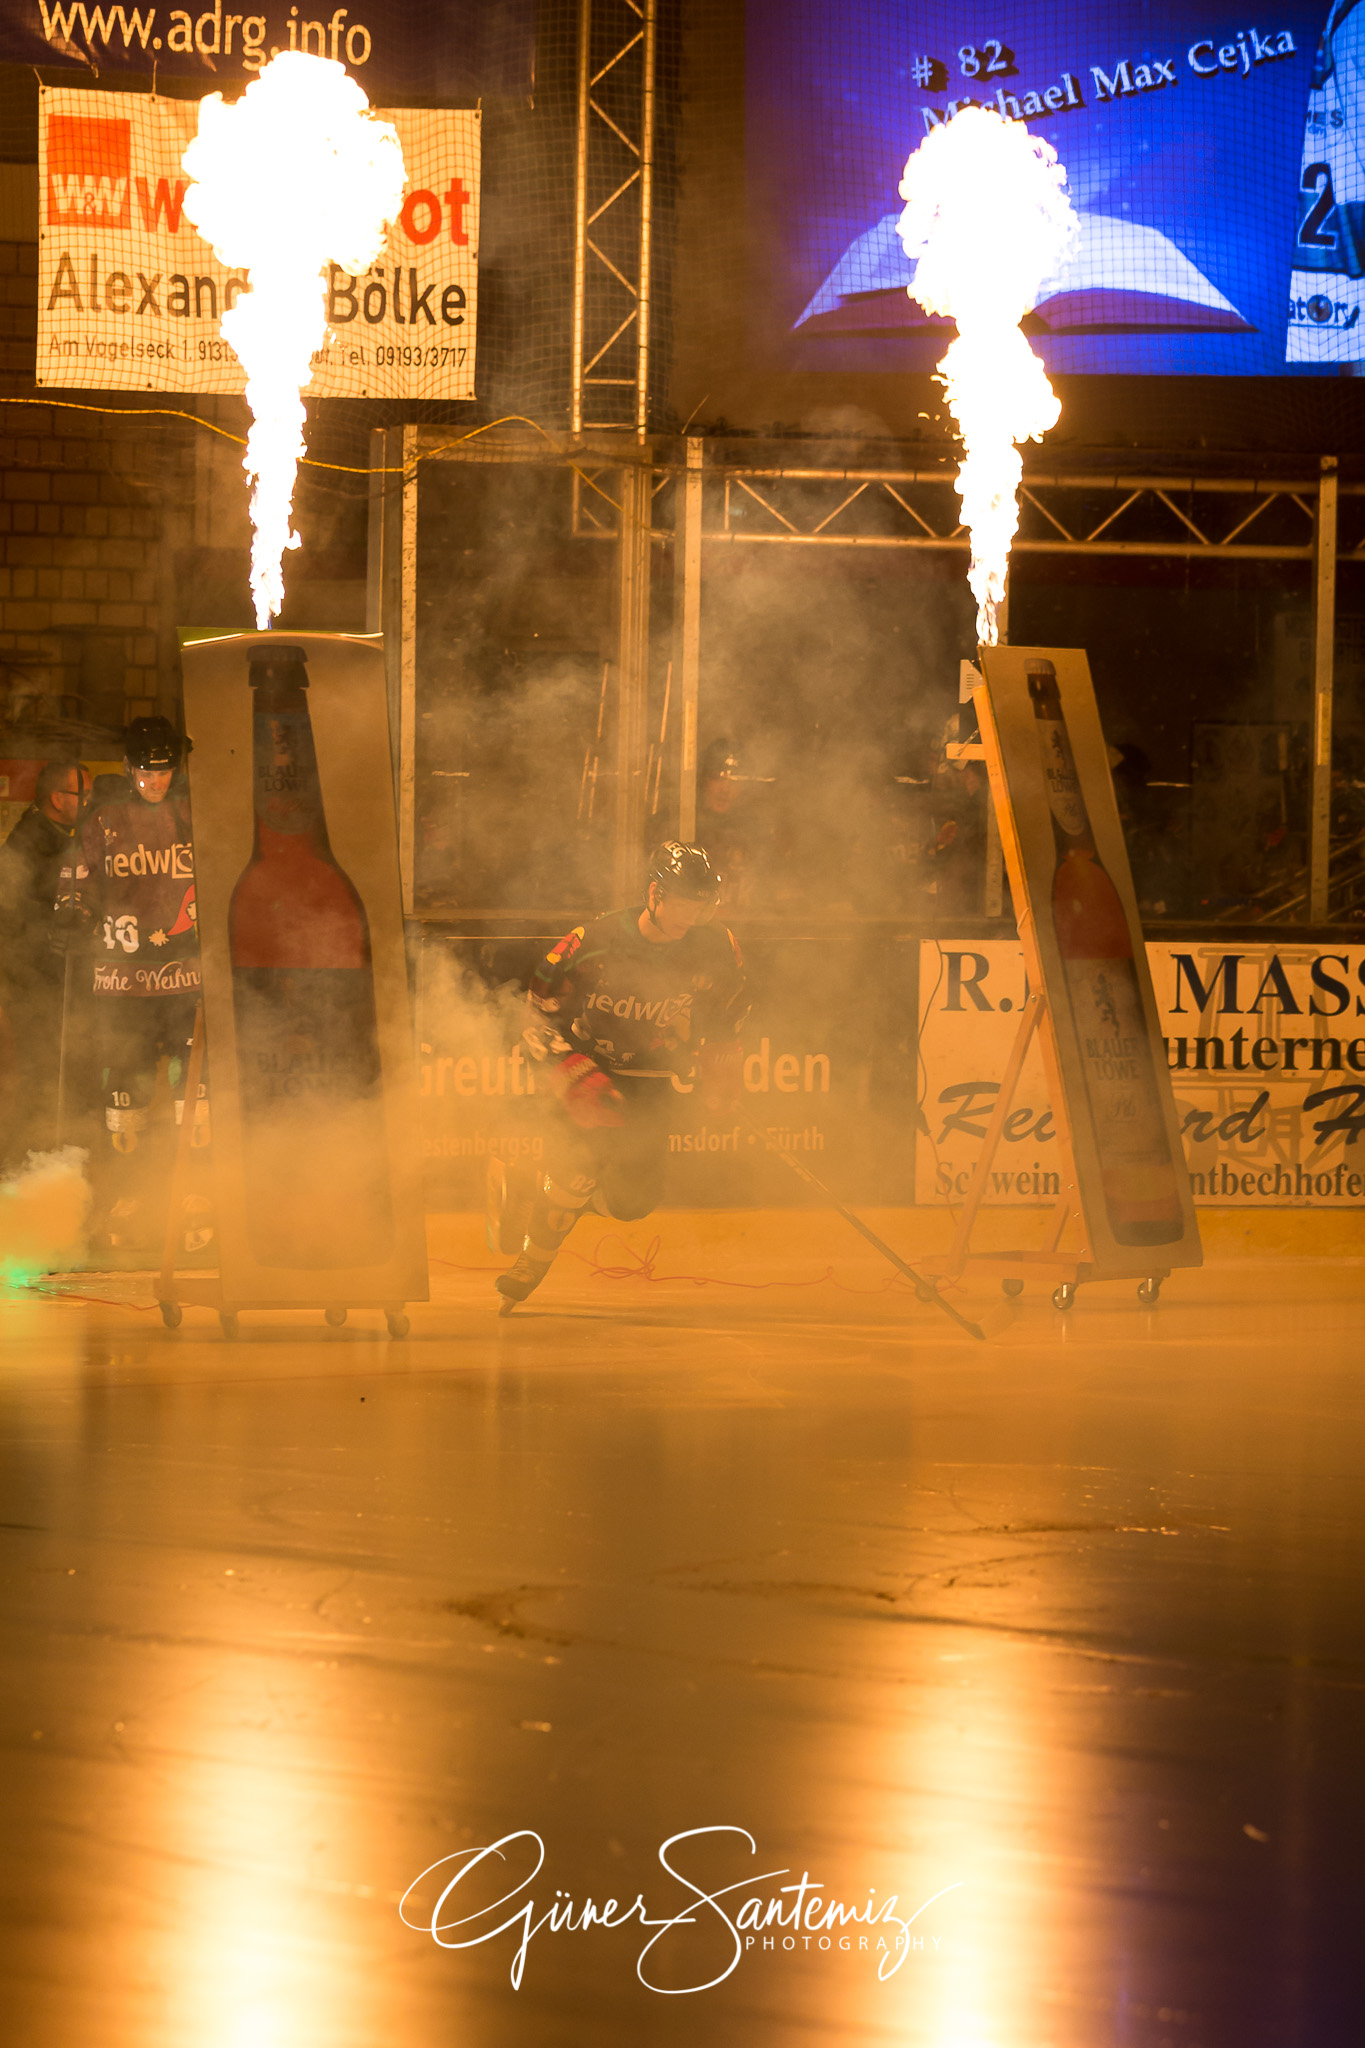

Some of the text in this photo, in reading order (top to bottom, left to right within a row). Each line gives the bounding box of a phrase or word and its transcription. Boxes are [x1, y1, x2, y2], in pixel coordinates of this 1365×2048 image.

[38, 0, 372, 71] www.adrg.info
[957, 39, 1008, 78] 82
[1089, 58, 1177, 99] Max
[1187, 26, 1298, 76] Cejka
[324, 263, 467, 327] Bölke
[50, 334, 80, 357] Am
[86, 334, 175, 363] Vogelseck
[376, 346, 467, 368] 09193/3717
[136, 960, 201, 992] Weihn
